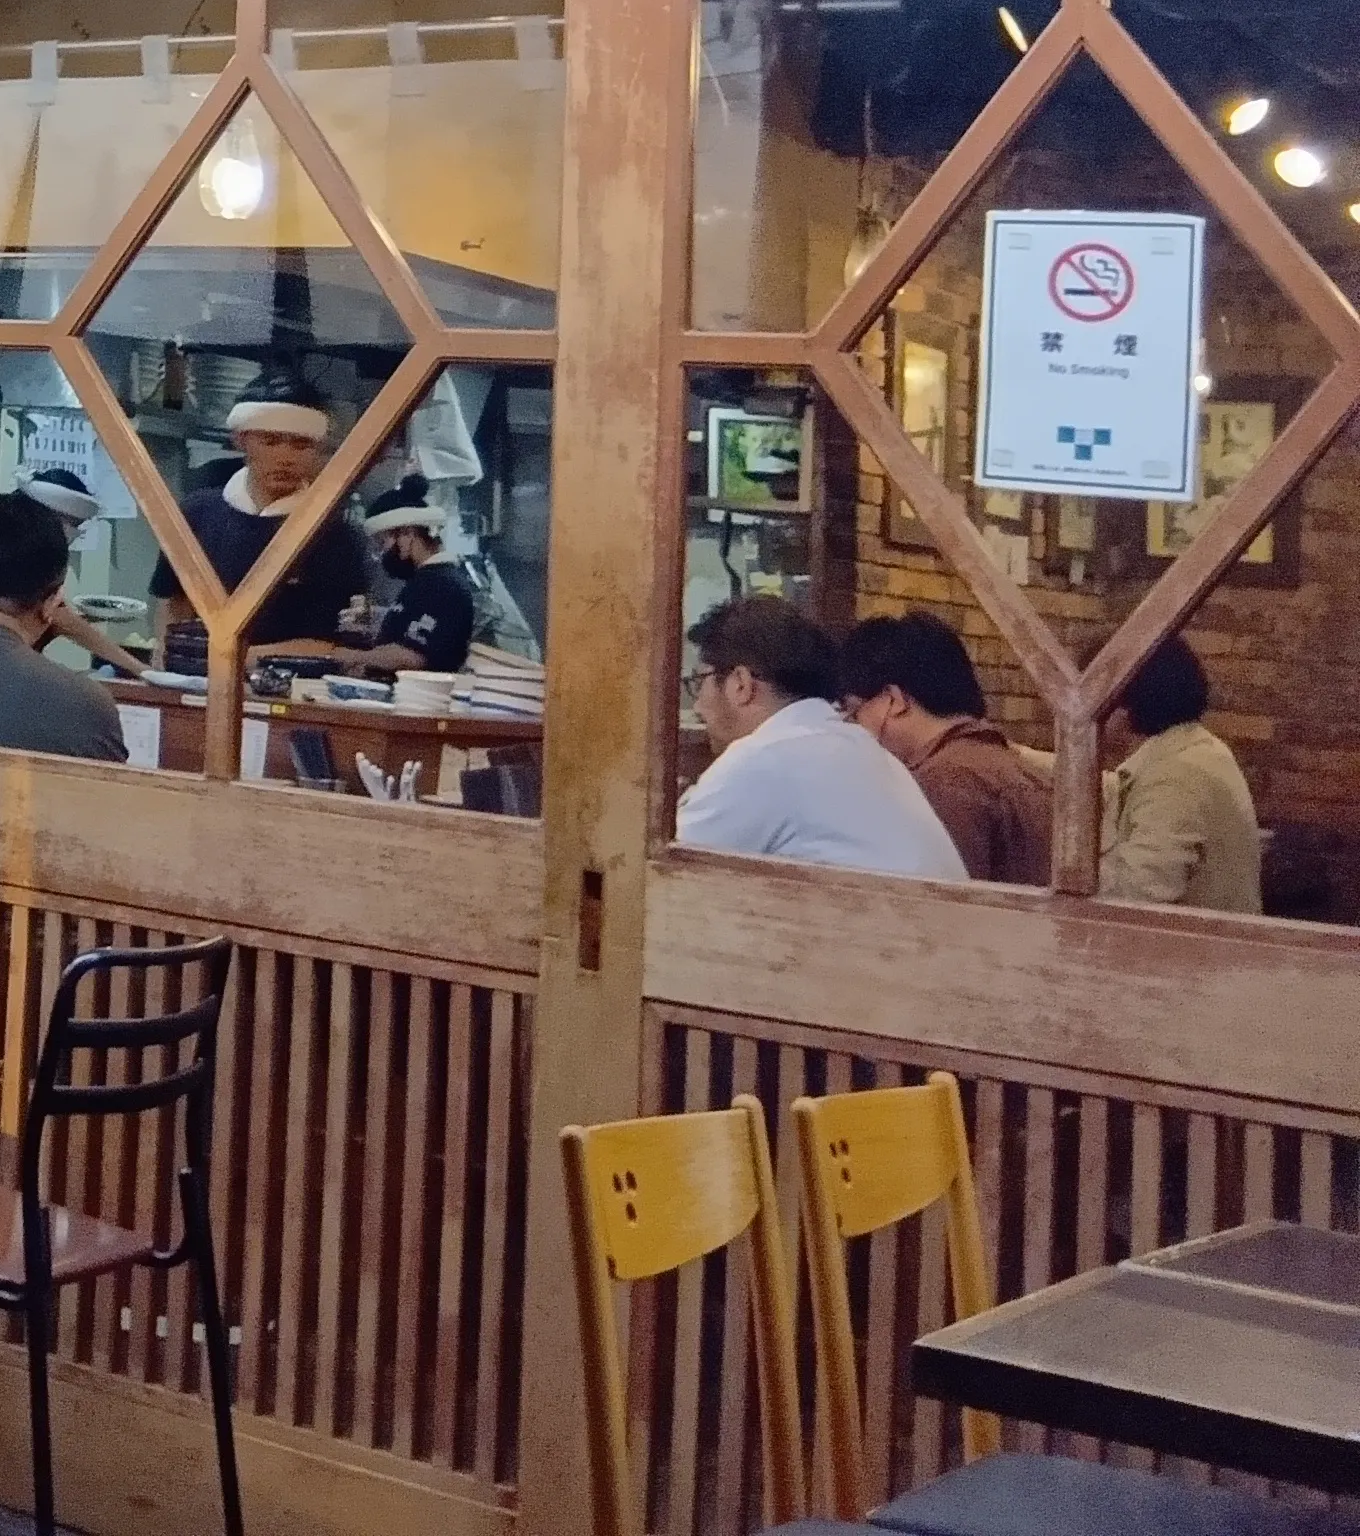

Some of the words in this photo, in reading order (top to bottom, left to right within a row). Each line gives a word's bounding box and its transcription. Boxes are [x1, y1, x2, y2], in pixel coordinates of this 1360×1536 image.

[1040, 331, 1139, 357] 禁煙
[1047, 361, 1067, 375] No
[1070, 363, 1131, 380] Smoking
